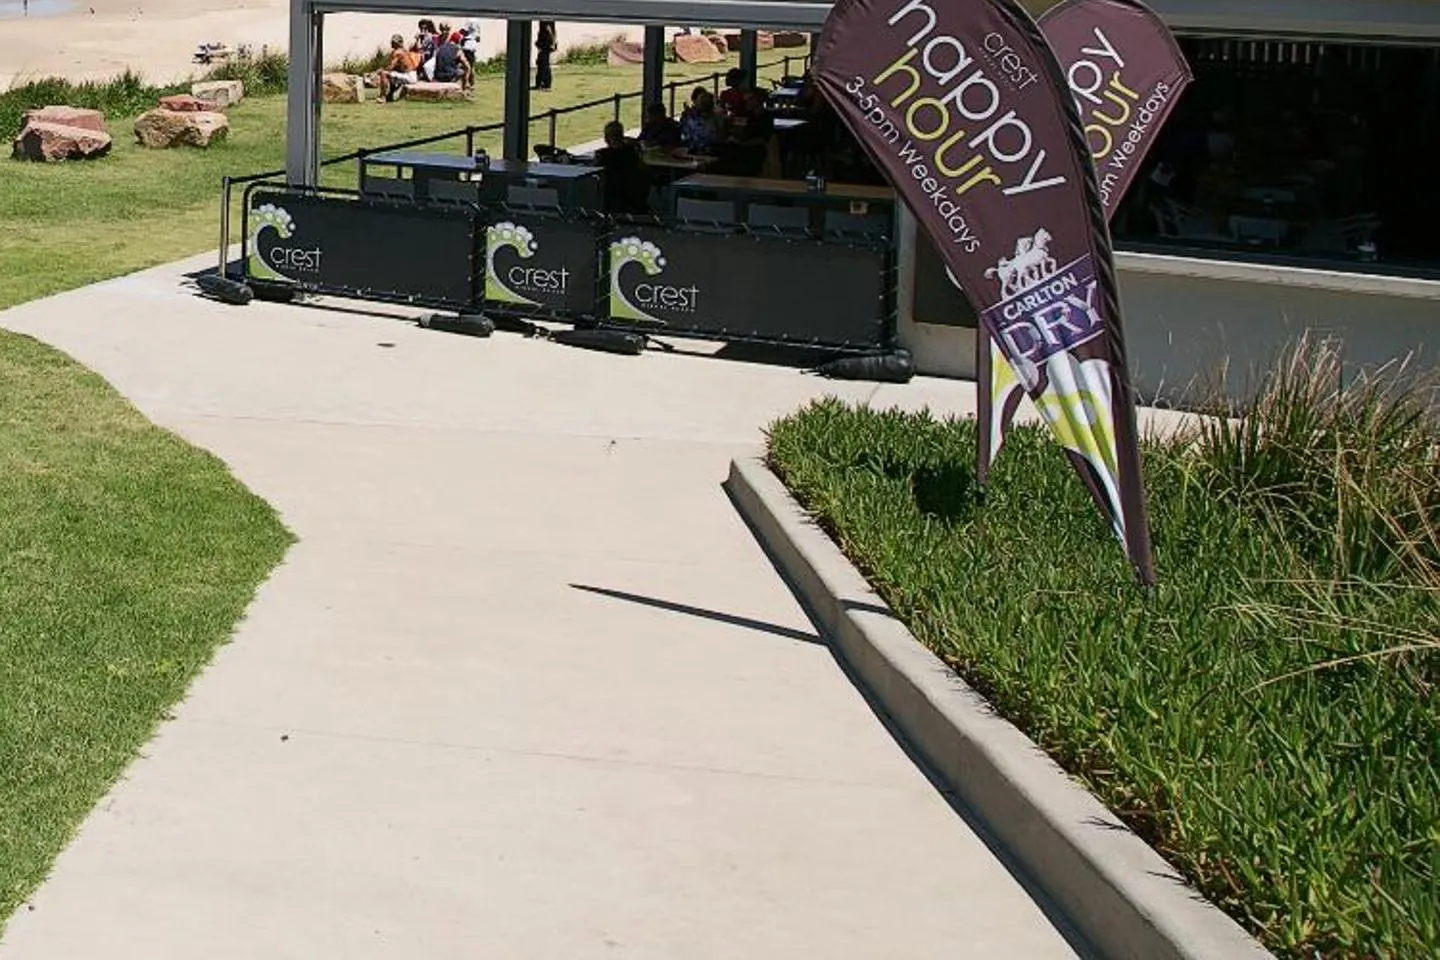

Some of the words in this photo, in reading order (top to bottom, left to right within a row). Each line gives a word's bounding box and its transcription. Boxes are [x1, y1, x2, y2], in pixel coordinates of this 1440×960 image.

[984, 32, 1038, 89] crest
[872, 47, 1002, 195] hour
[1085, 70, 1140, 159] our
[1110, 81, 1170, 170] Weekdays
[845, 76, 901, 145] 3-5pm
[898, 141, 981, 254] Weekdays
[270, 247, 323, 268] crest
[508, 266, 570, 289] crest
[635, 283, 700, 308] crest
[1001, 280, 1102, 359] DRY
[1003, 272, 1078, 320] CARLTON
